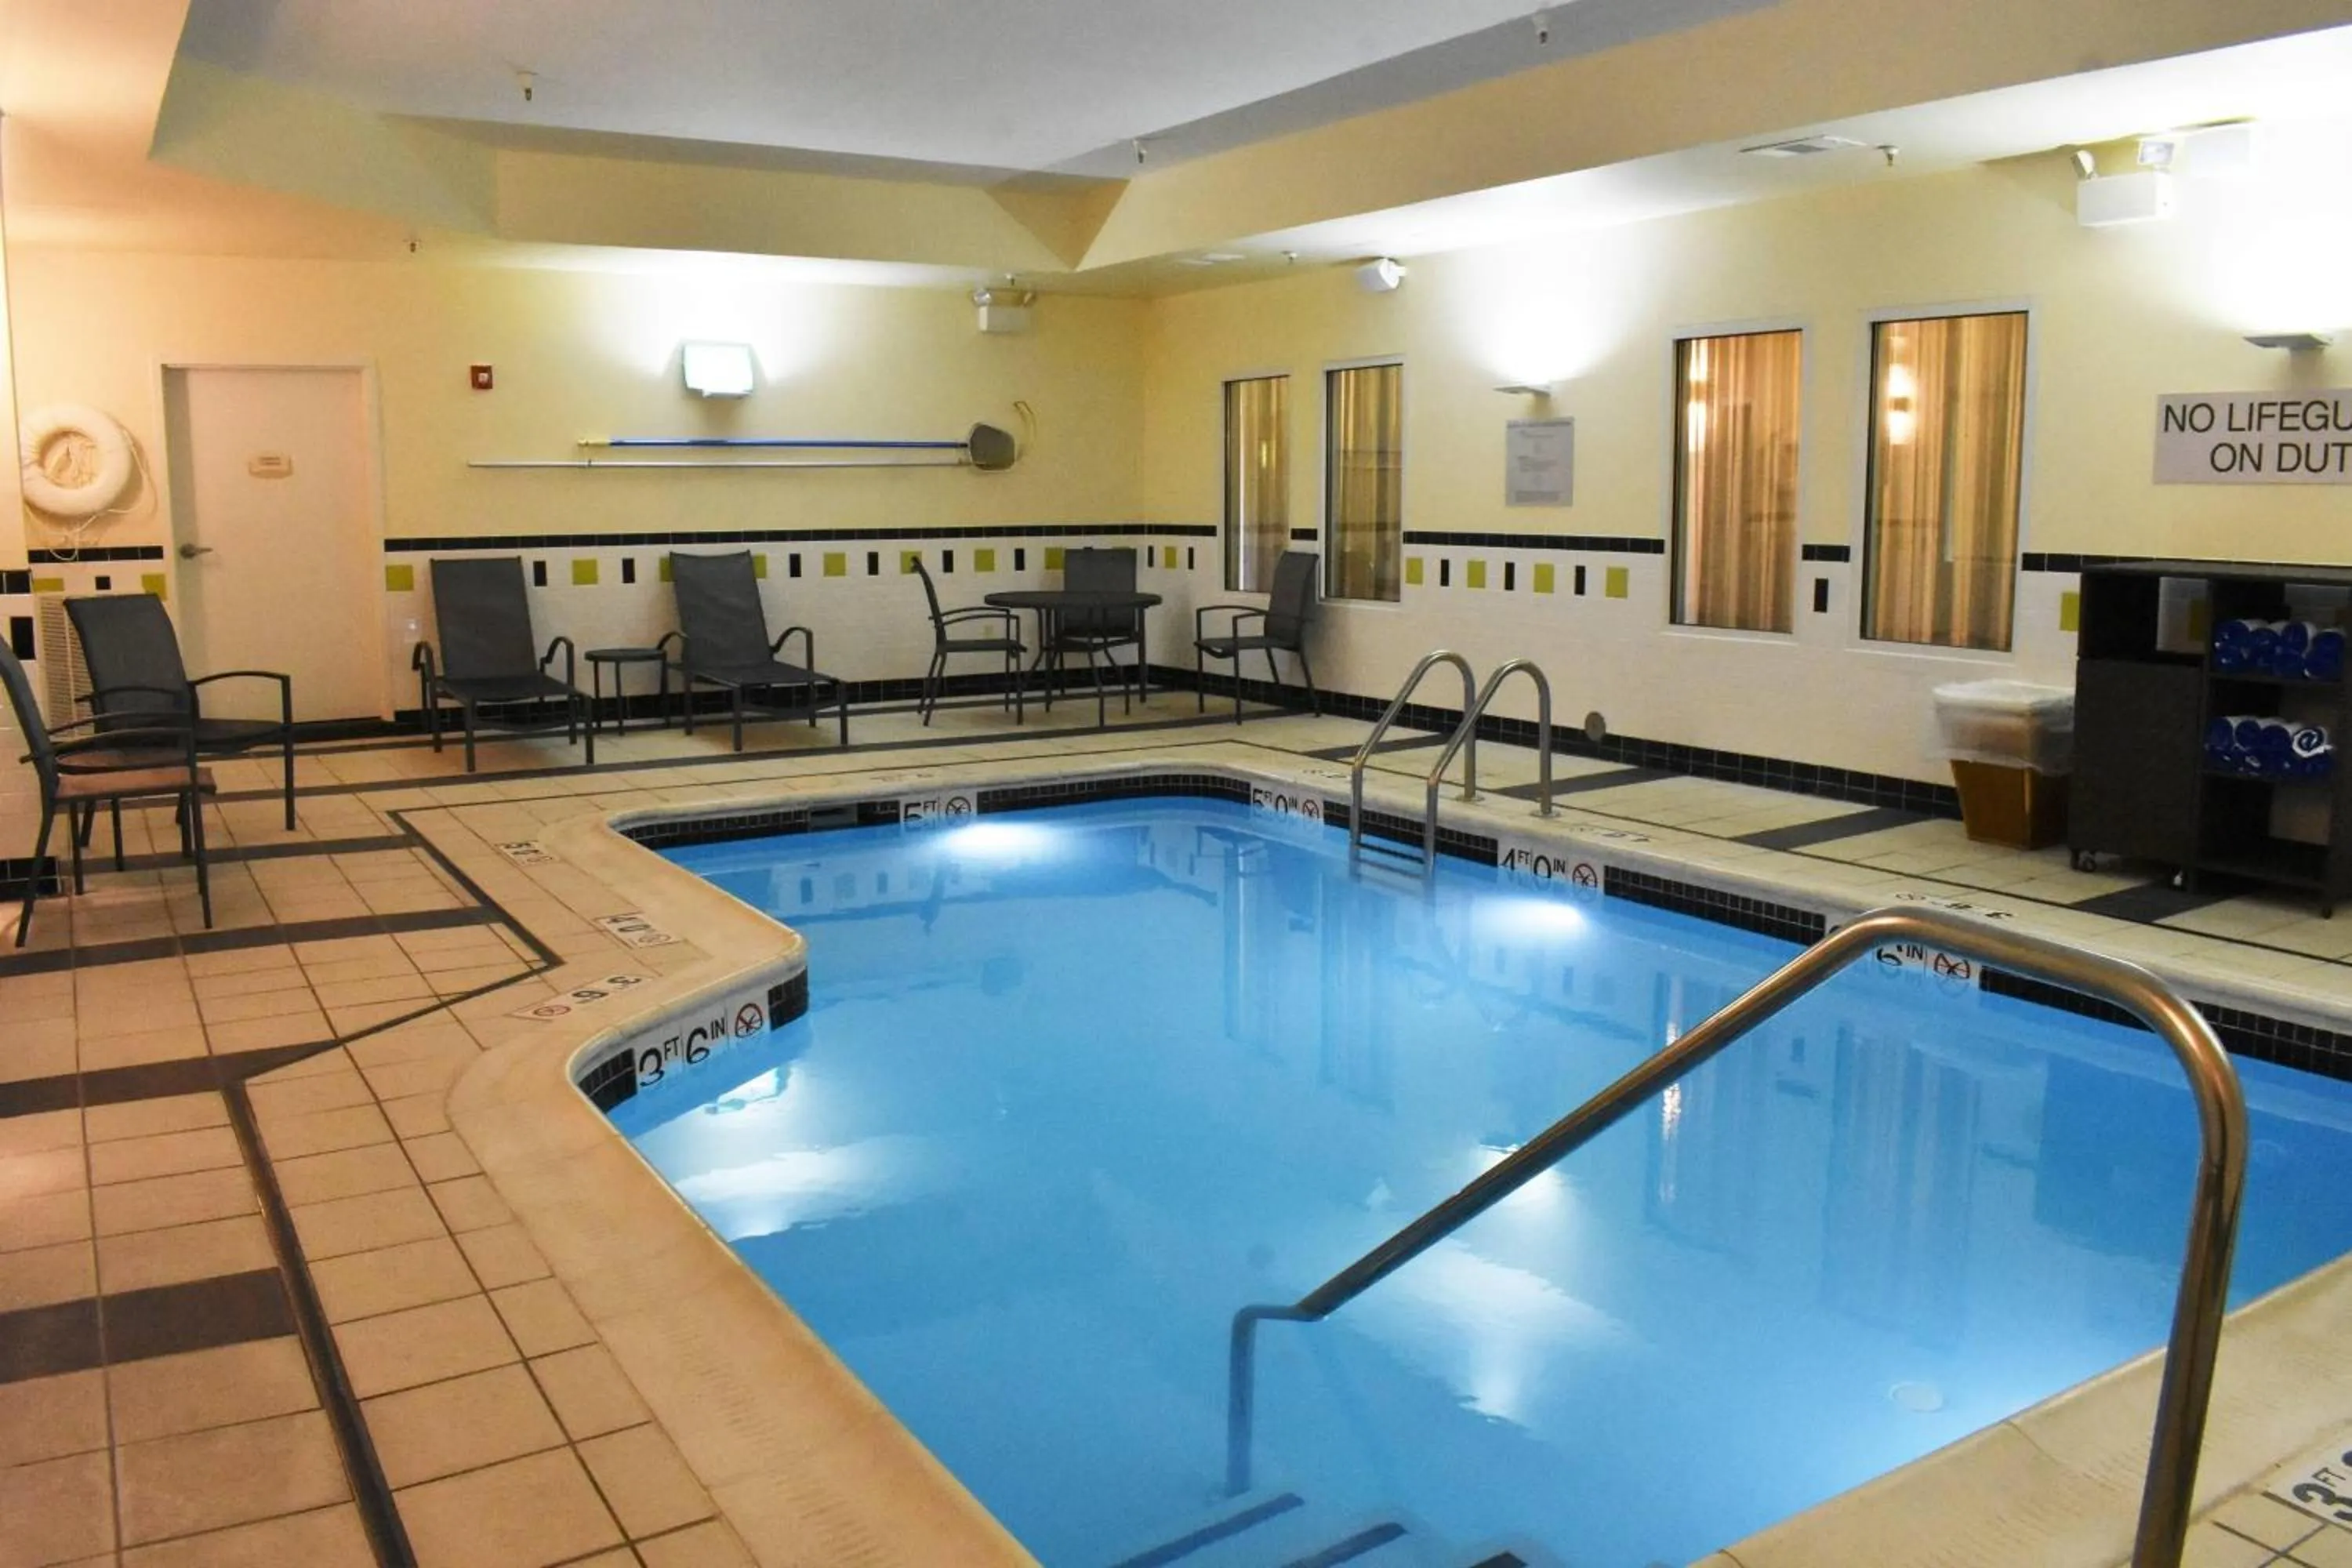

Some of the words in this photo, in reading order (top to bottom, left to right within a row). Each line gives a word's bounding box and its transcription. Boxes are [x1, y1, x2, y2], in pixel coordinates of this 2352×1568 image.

[2164, 402, 2216, 434] NO
[2209, 442, 2263, 473] ON
[2276, 442, 2352, 474] DUT
